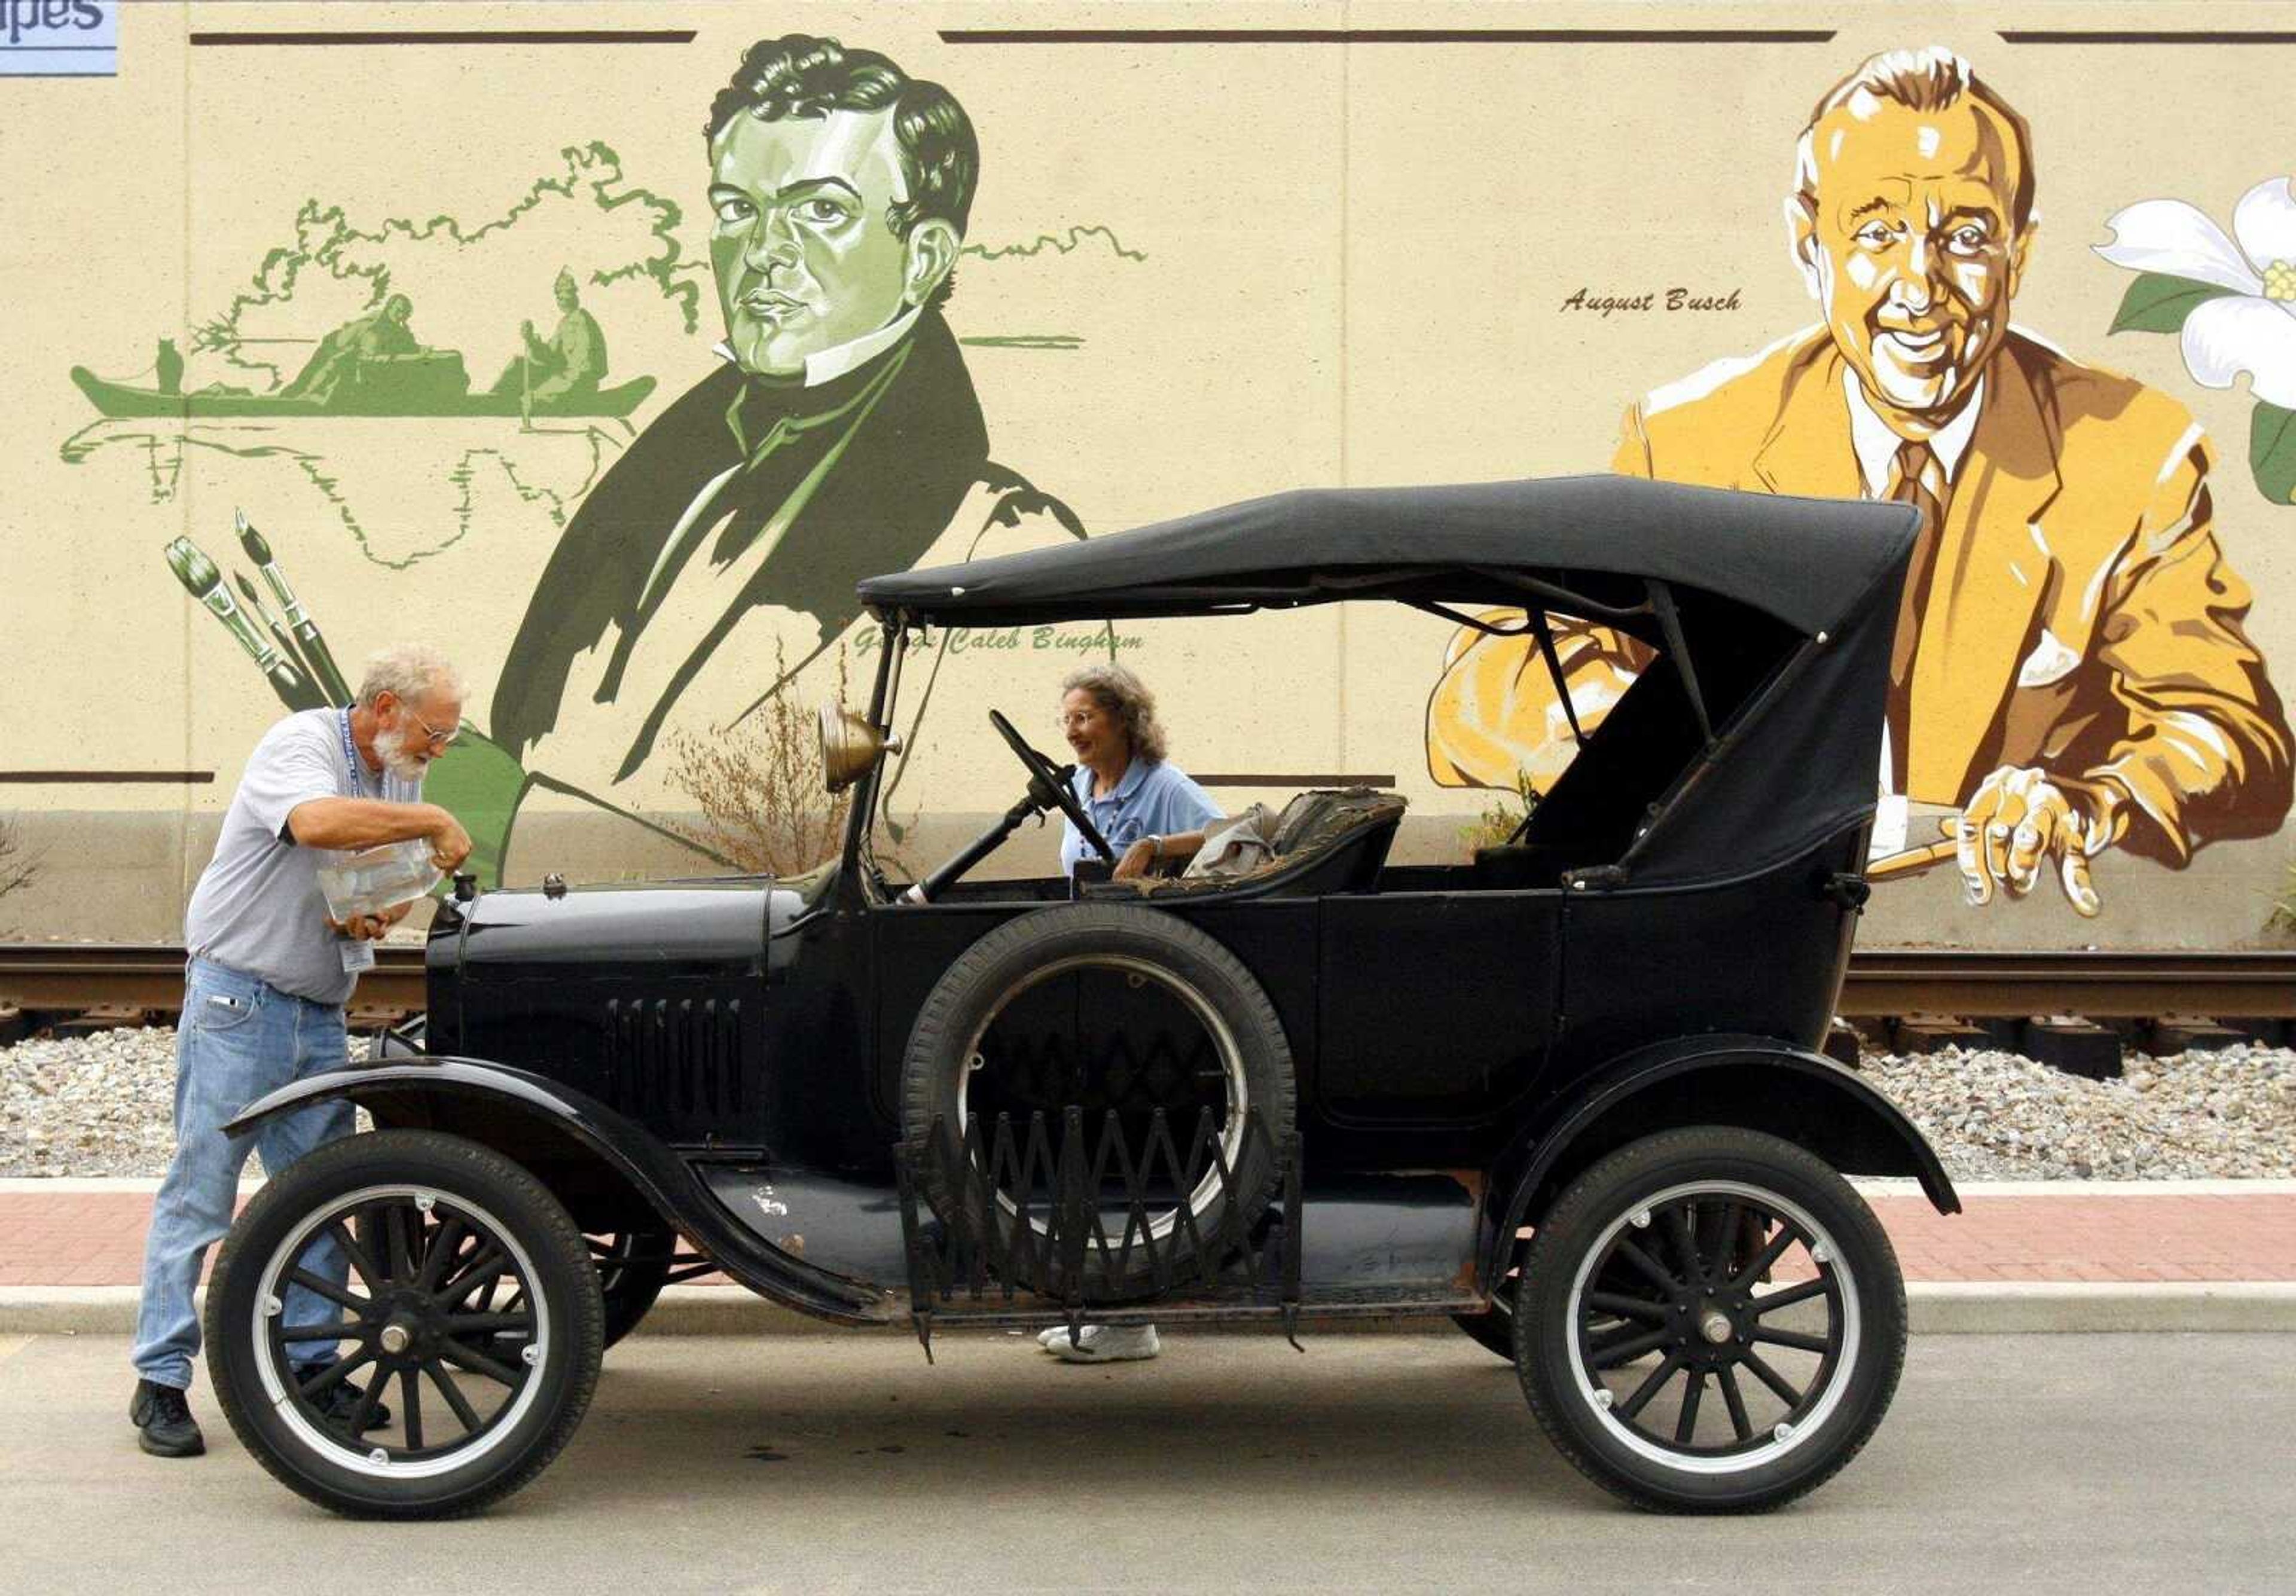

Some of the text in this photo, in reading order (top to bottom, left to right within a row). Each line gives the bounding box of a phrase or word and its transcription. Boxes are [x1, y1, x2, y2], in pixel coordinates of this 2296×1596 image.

[0, 0, 103, 44] pes
[1559, 287, 1742, 318] August Busch
[949, 627, 1021, 655] Caleb
[1032, 626, 1144, 657] Bingham
